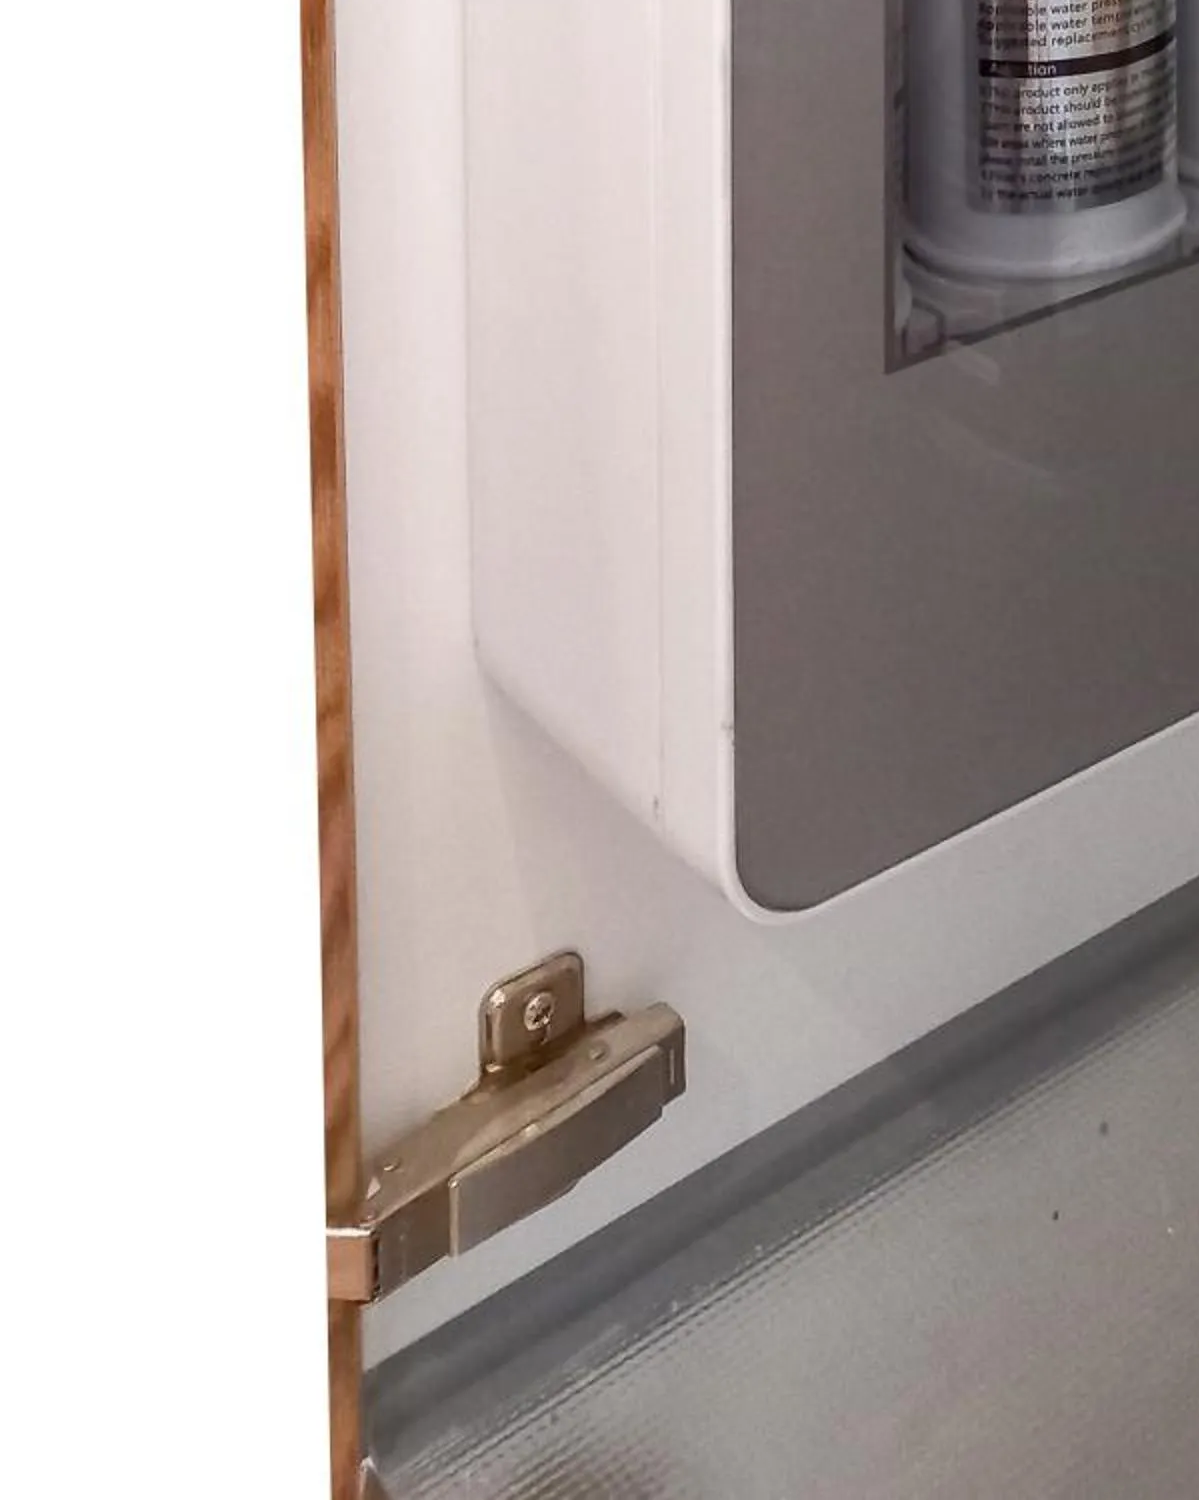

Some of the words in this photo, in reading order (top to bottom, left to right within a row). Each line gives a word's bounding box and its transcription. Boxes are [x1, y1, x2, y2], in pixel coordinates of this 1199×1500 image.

[1051, 3, 1088, 16] water
[1051, 17, 1088, 31] water
[1063, 82, 1089, 97] only
[1063, 97, 1101, 112] should
